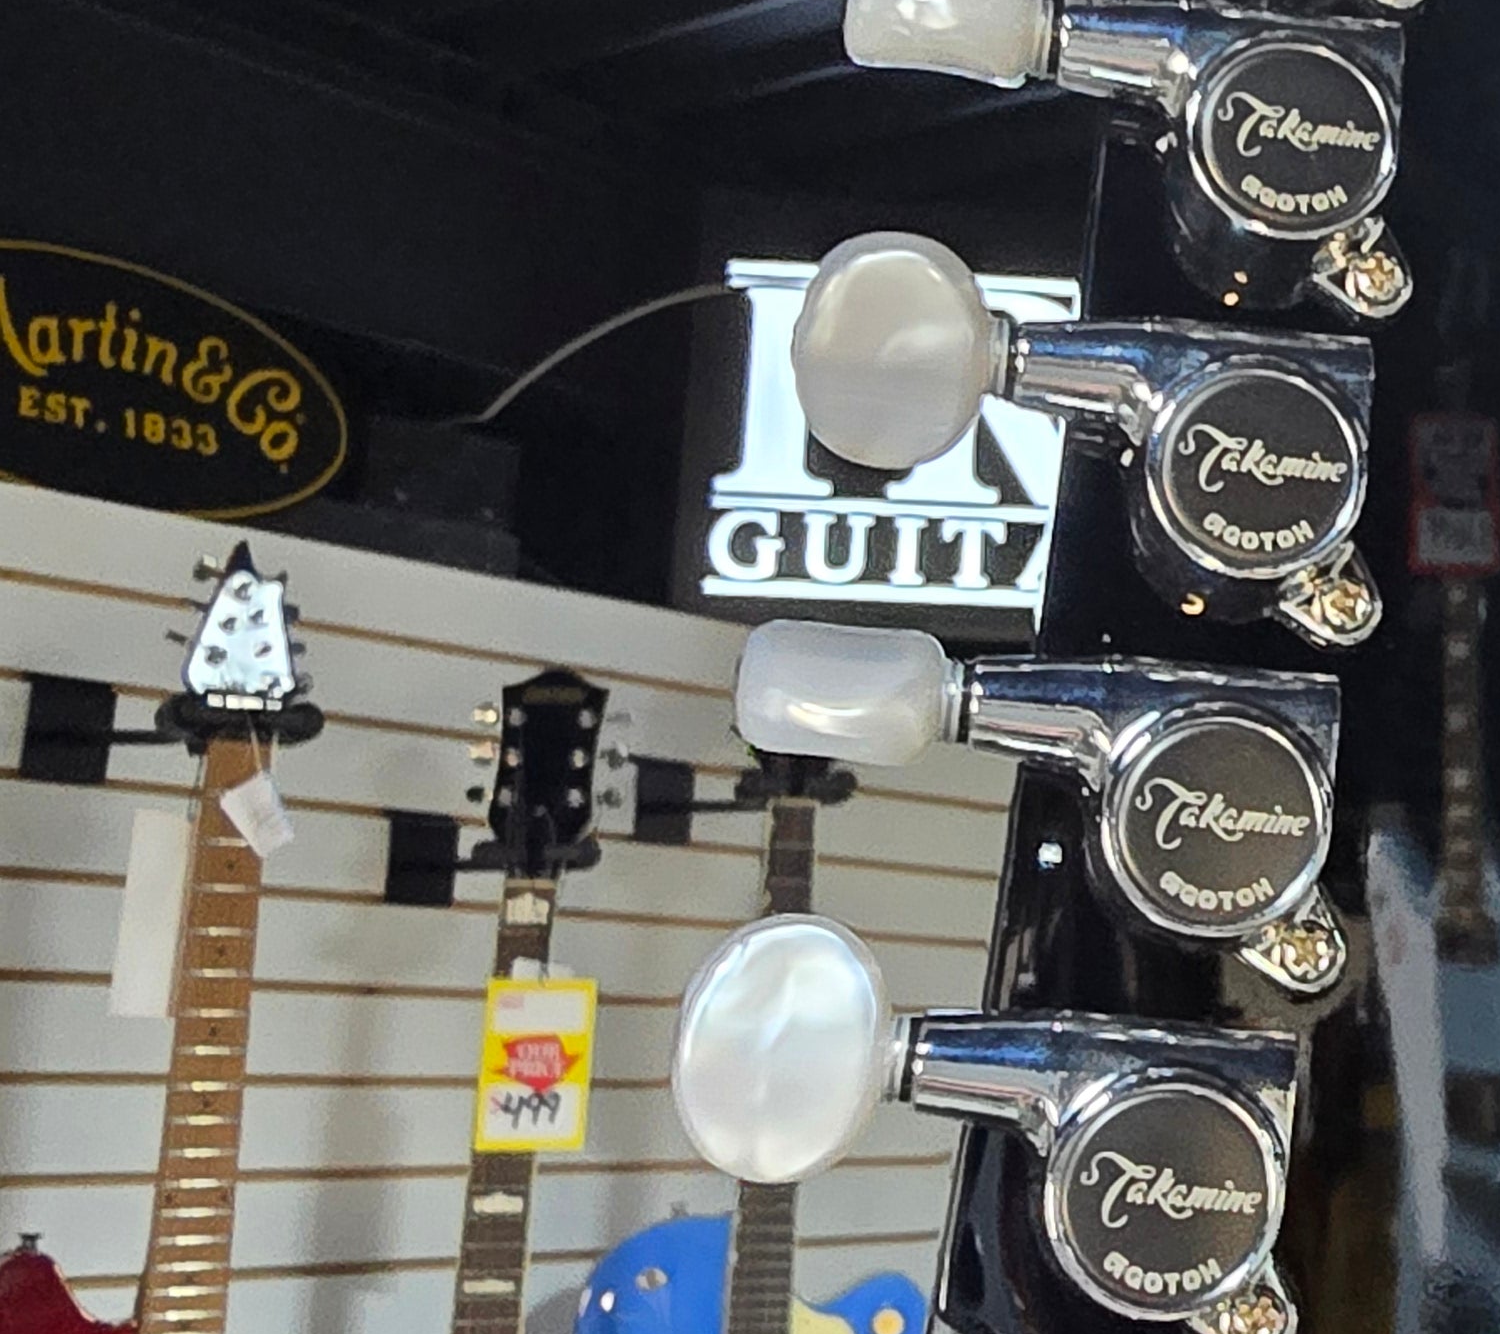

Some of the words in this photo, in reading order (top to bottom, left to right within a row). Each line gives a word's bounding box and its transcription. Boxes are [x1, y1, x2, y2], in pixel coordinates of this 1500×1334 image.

[1217, 91, 1381, 156] Takamine
[17, 384, 107, 434] EST.
[124, 406, 219, 456] 1833
[1178, 423, 1348, 493] Takamine
[1135, 777, 1311, 850] Takamine
[1079, 1151, 1263, 1229] Takamine
